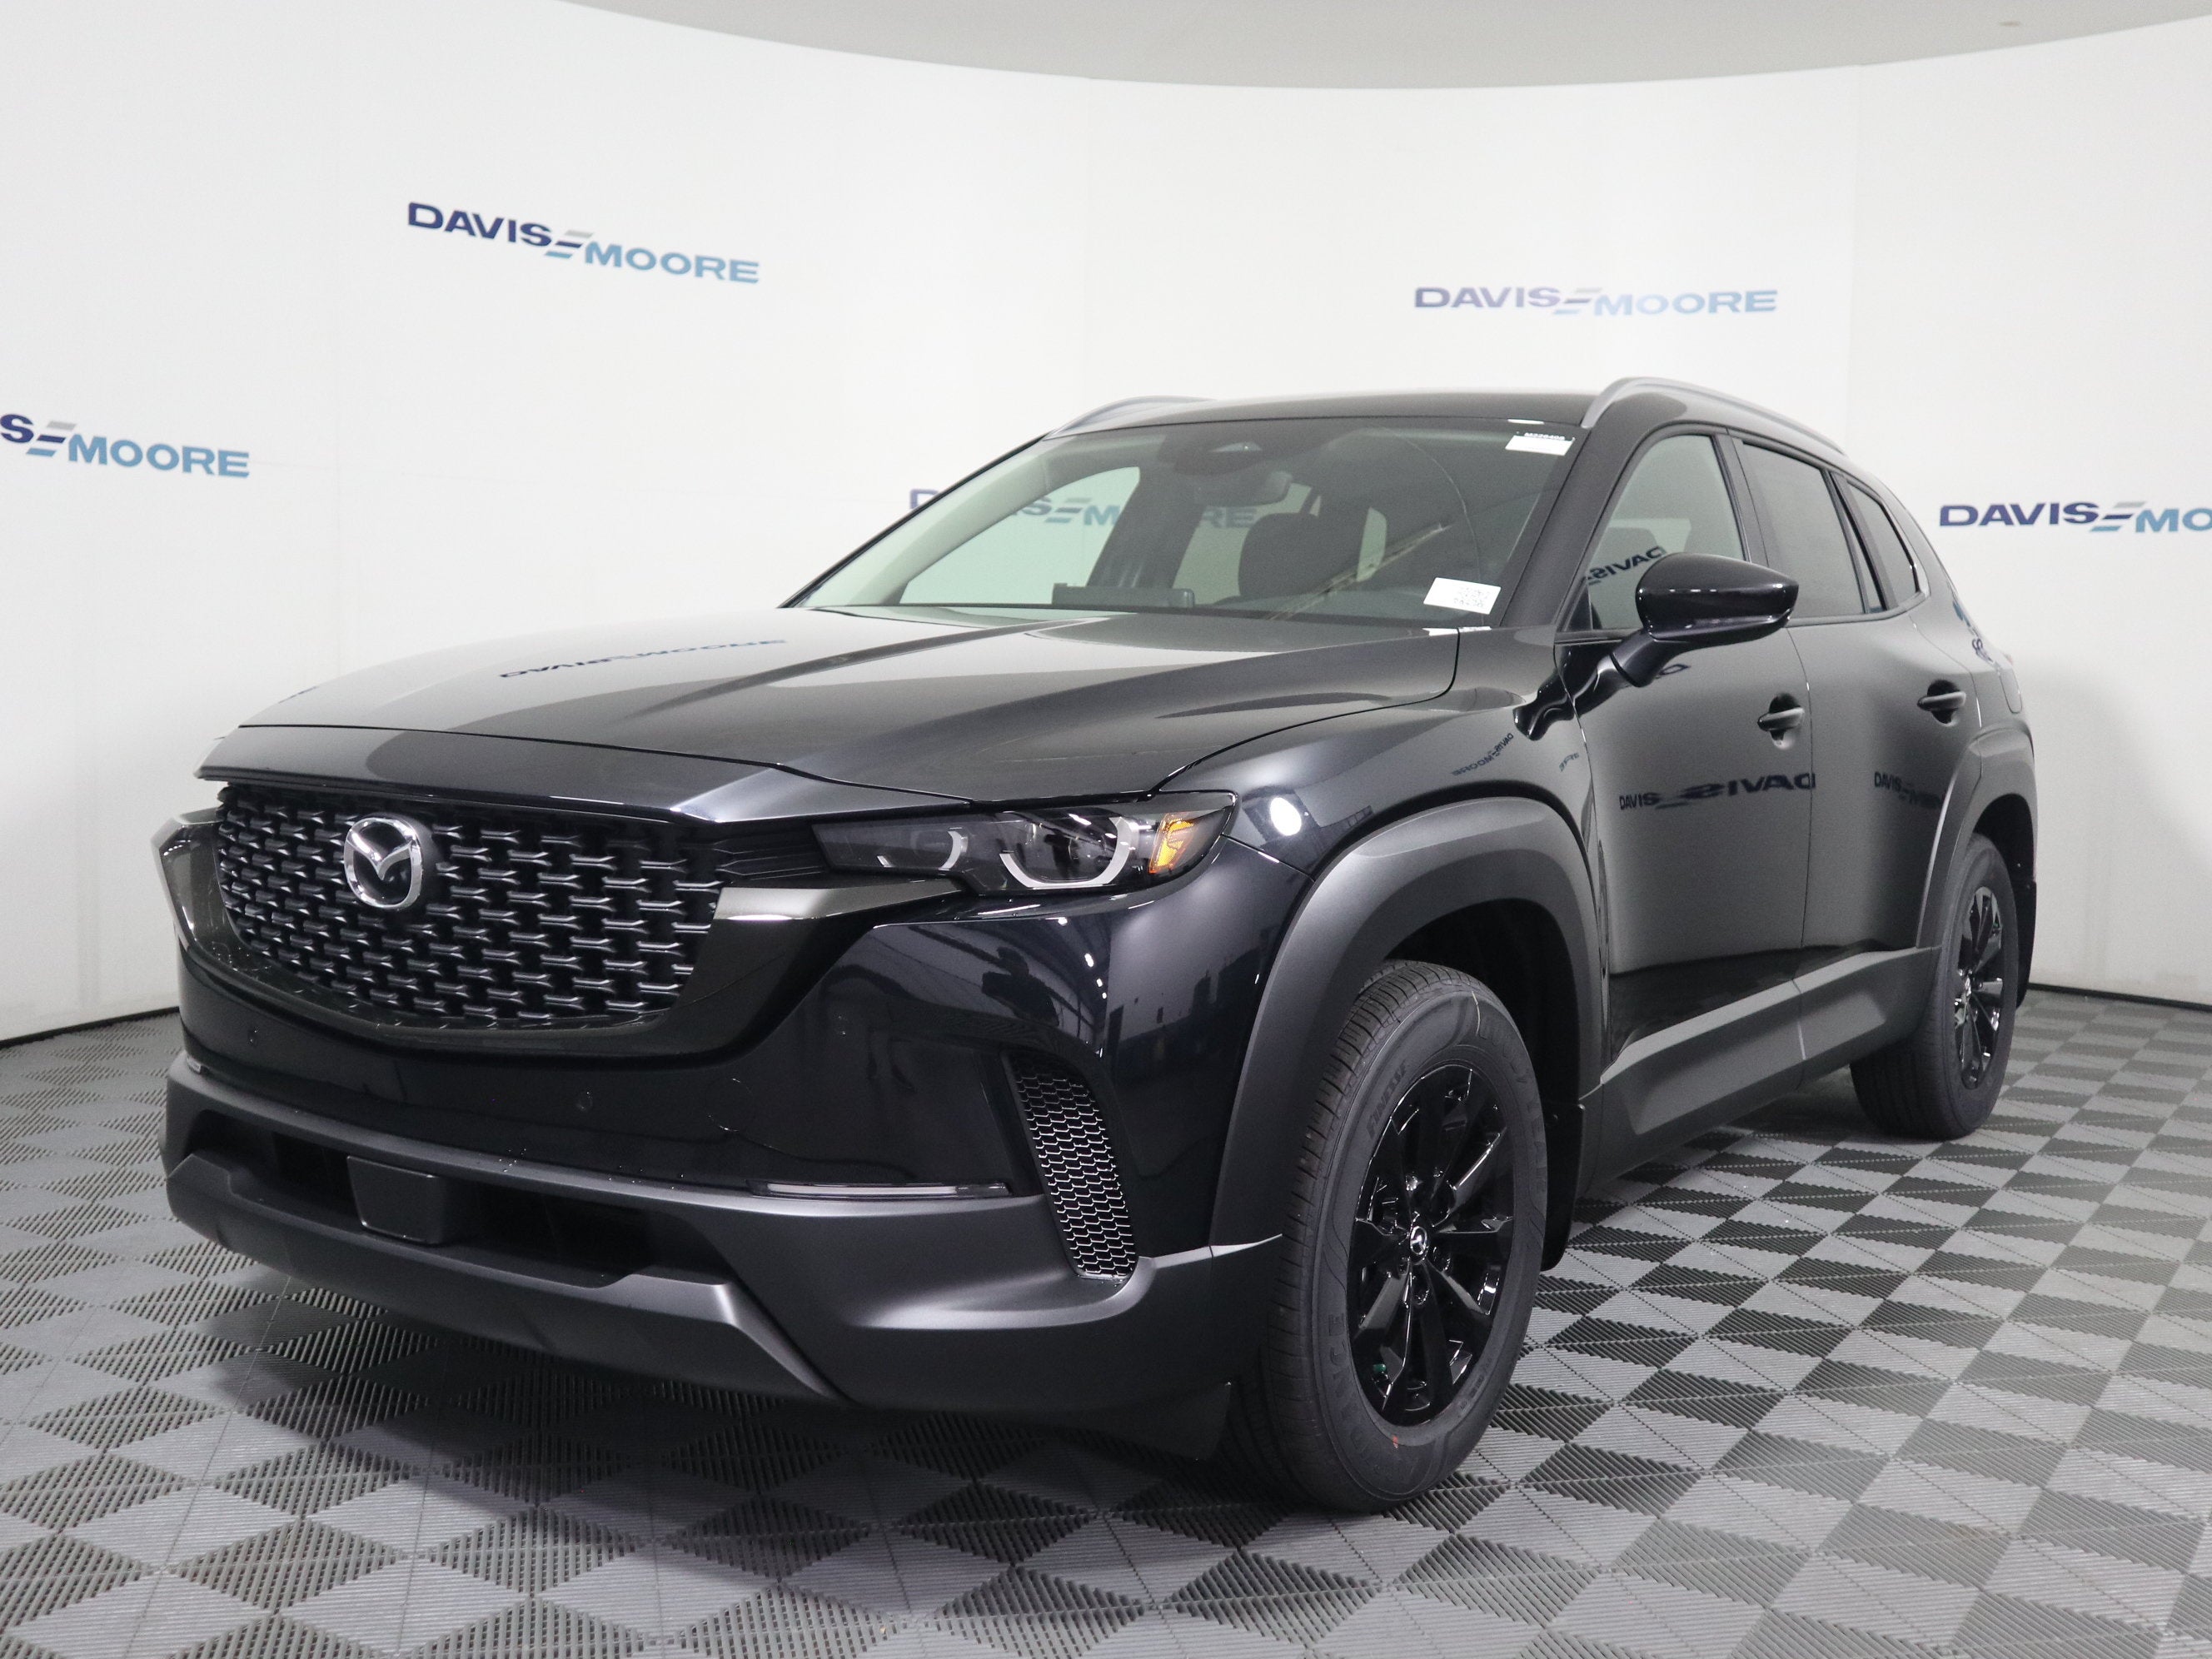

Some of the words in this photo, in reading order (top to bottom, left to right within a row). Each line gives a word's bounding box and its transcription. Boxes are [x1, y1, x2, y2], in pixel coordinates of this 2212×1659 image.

[408, 202, 552, 247] DAVIS
[585, 241, 760, 284] MOORE
[1415, 286, 1562, 308] DAVIS
[1594, 290, 1778, 316] MOORE
[68, 434, 250, 478] MOORE
[1940, 502, 2100, 526] DAVIS
